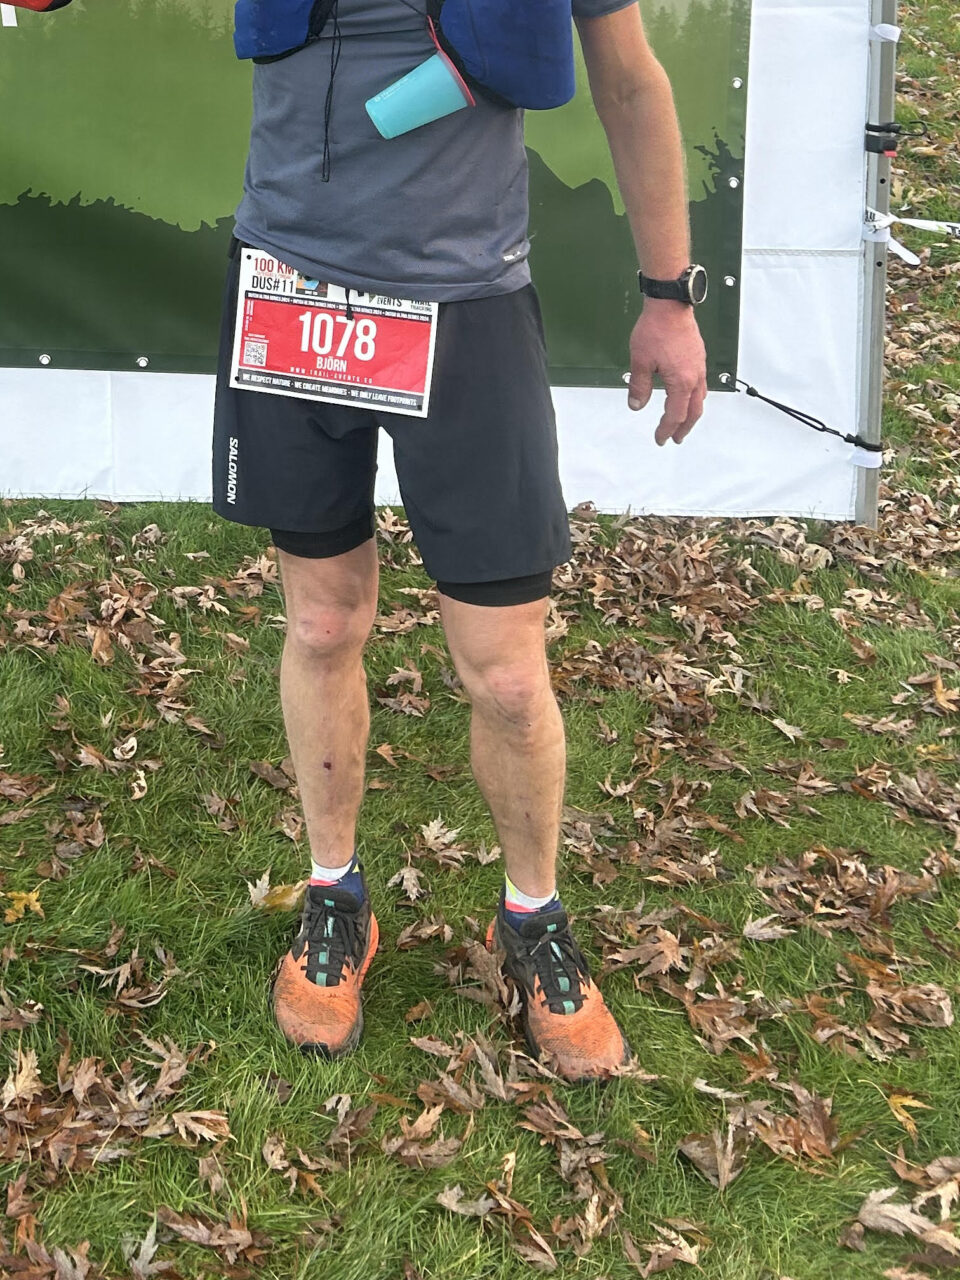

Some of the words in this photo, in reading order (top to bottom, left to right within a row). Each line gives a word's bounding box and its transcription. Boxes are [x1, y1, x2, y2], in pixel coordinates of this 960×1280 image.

[254, 257, 274, 273] 100
[277, 261, 295, 275] KM
[252, 275, 294, 293] DUS#11
[376, 296, 402, 307] EVENTS
[299, 311, 377, 361] 1078
[316, 356, 347, 372] BJÖRN
[242, 373, 250, 381] WE
[250, 374, 272, 384] RESPECT
[303, 382, 321, 391] CREATE
[351, 389, 359, 397] WE
[226, 436, 239, 505] SALOMON
